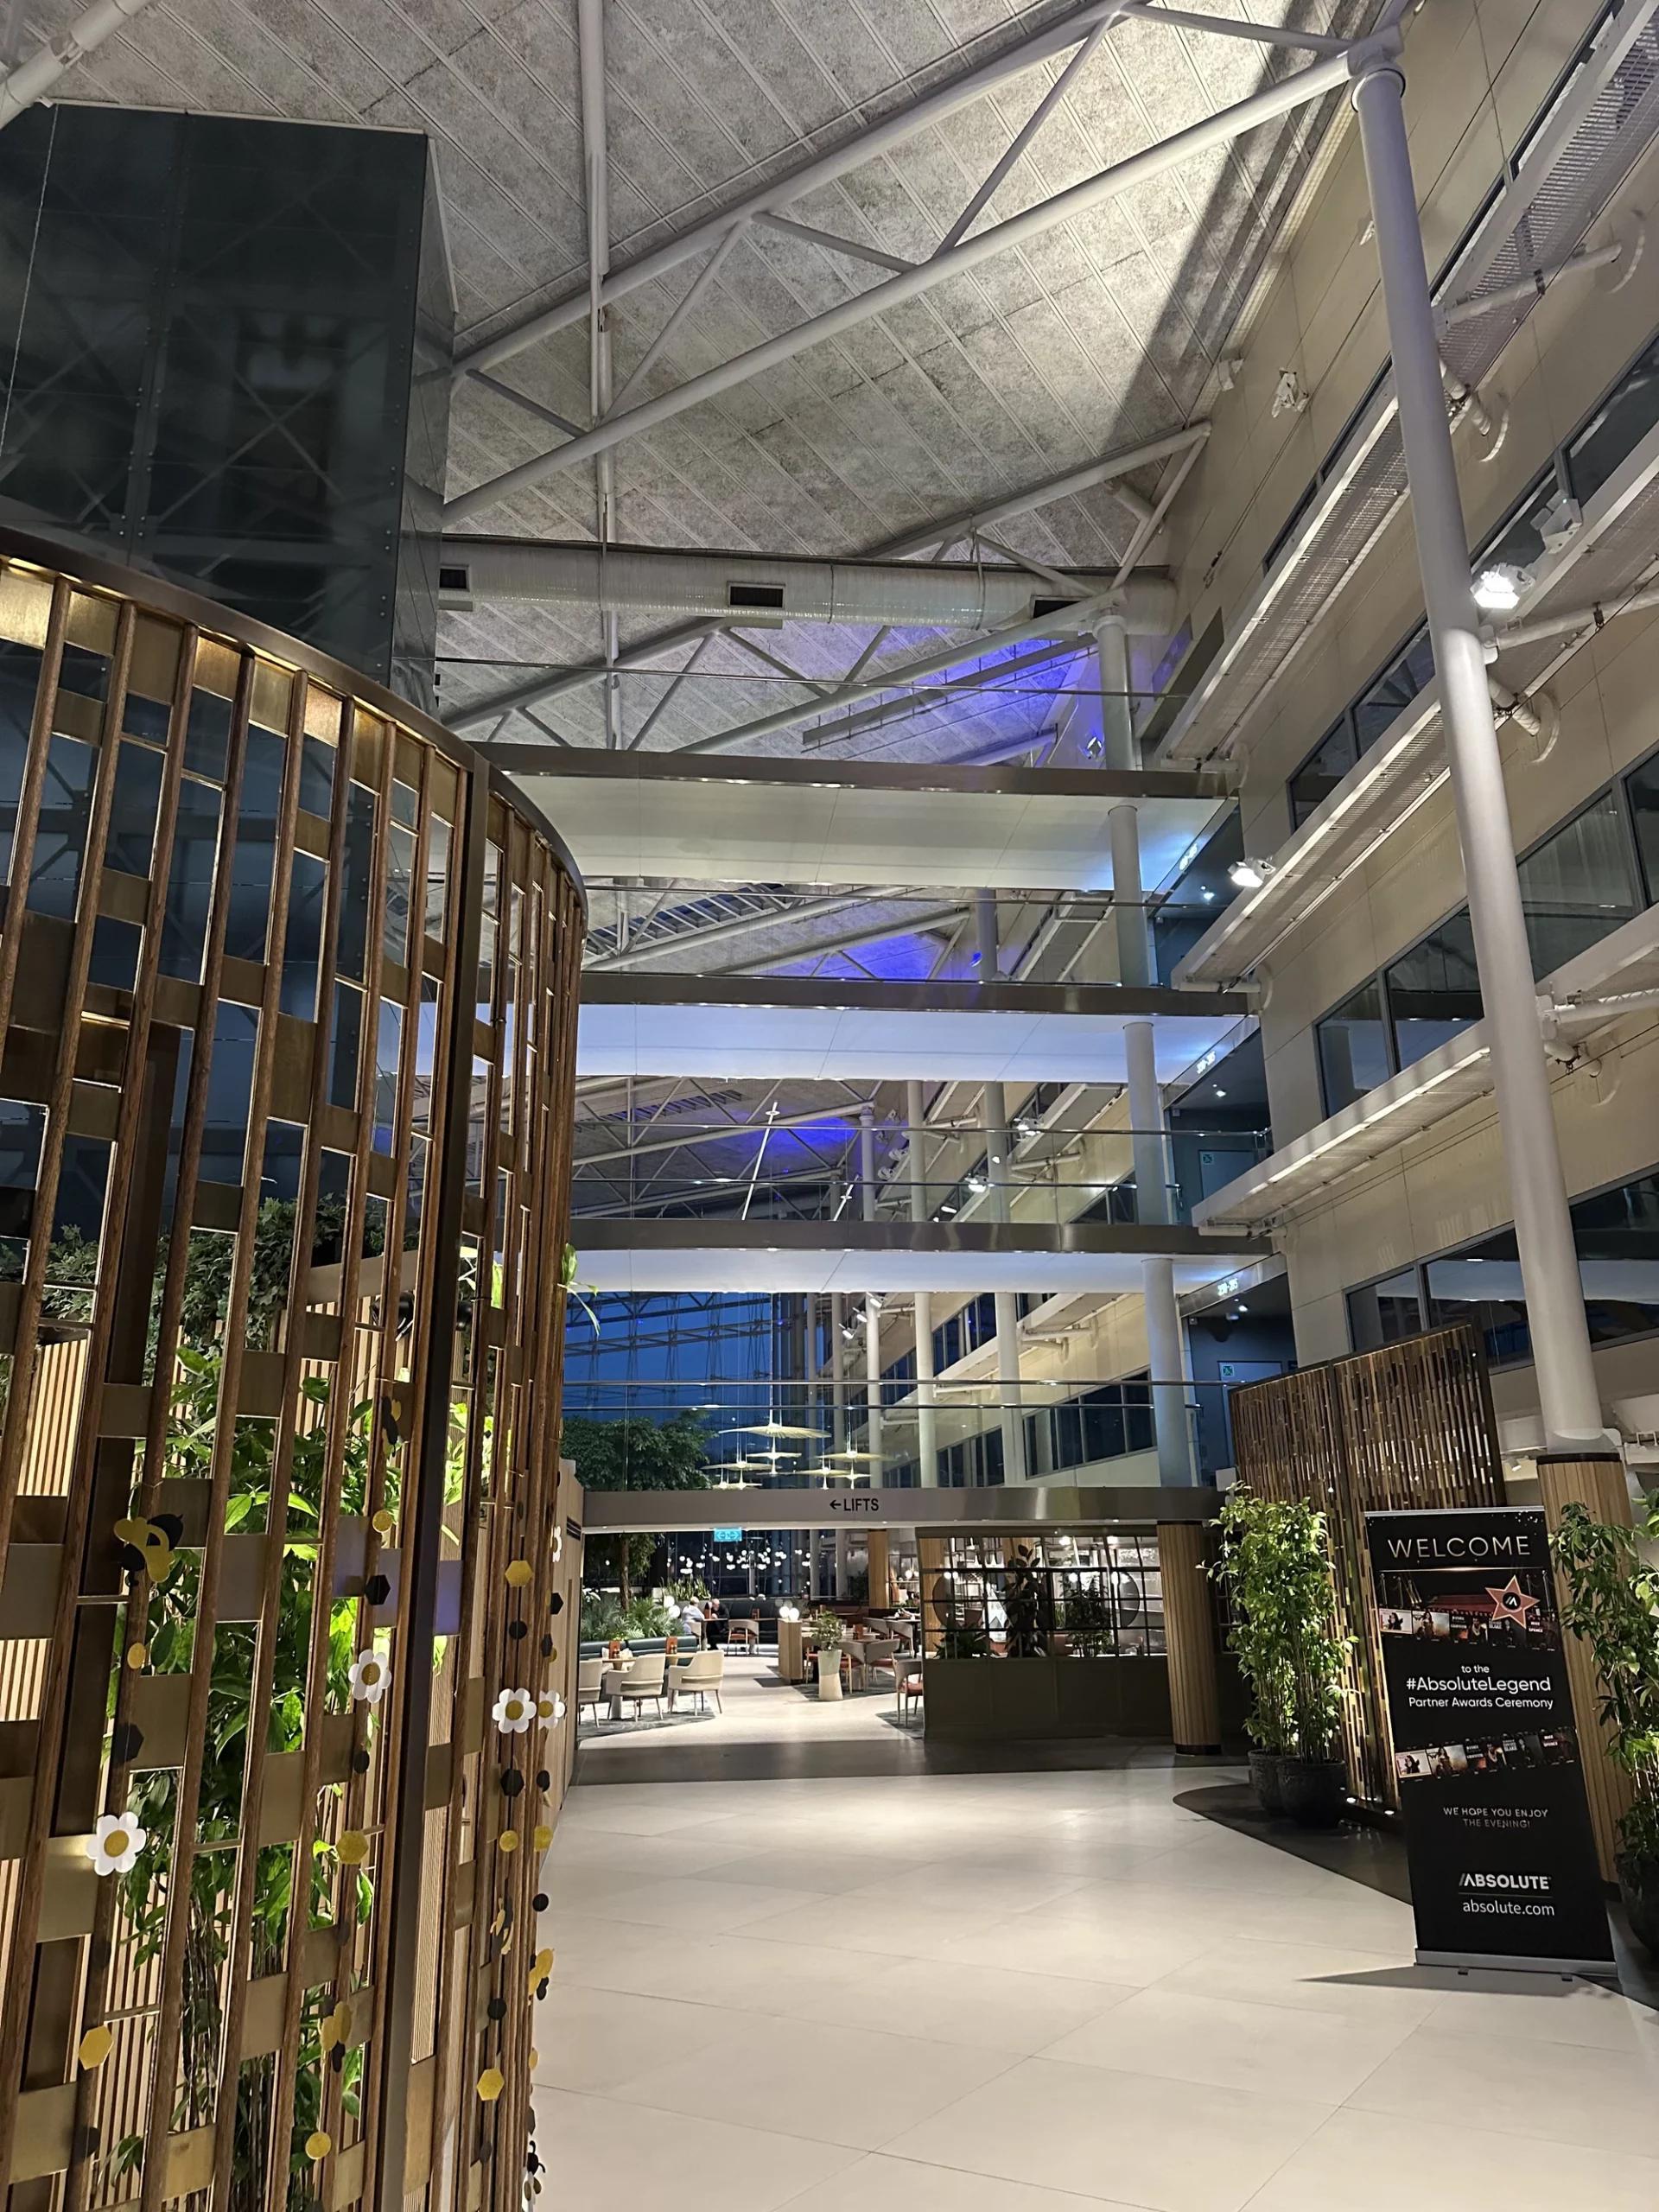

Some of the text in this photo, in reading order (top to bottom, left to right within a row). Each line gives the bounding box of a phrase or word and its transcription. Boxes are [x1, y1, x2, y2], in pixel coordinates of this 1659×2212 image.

[843, 1497, 880, 1511] LIFTS
[1387, 1535, 1530, 1558] WELCOME
[1473, 1664, 1490, 1673] the
[1406, 1676, 1552, 1694] #AbsoluteLegend
[1408, 1697, 1554, 1710] Partner Awards Ceremony
[1443, 1807, 1459, 1815] WE
[1515, 1808, 1548, 1818] ENJOY
[1463, 1818, 1530, 1828] THE EVENING!
[1459, 1873, 1550, 1890] ABSOLUTE
[1462, 1898, 1555, 1916] absolute.com
